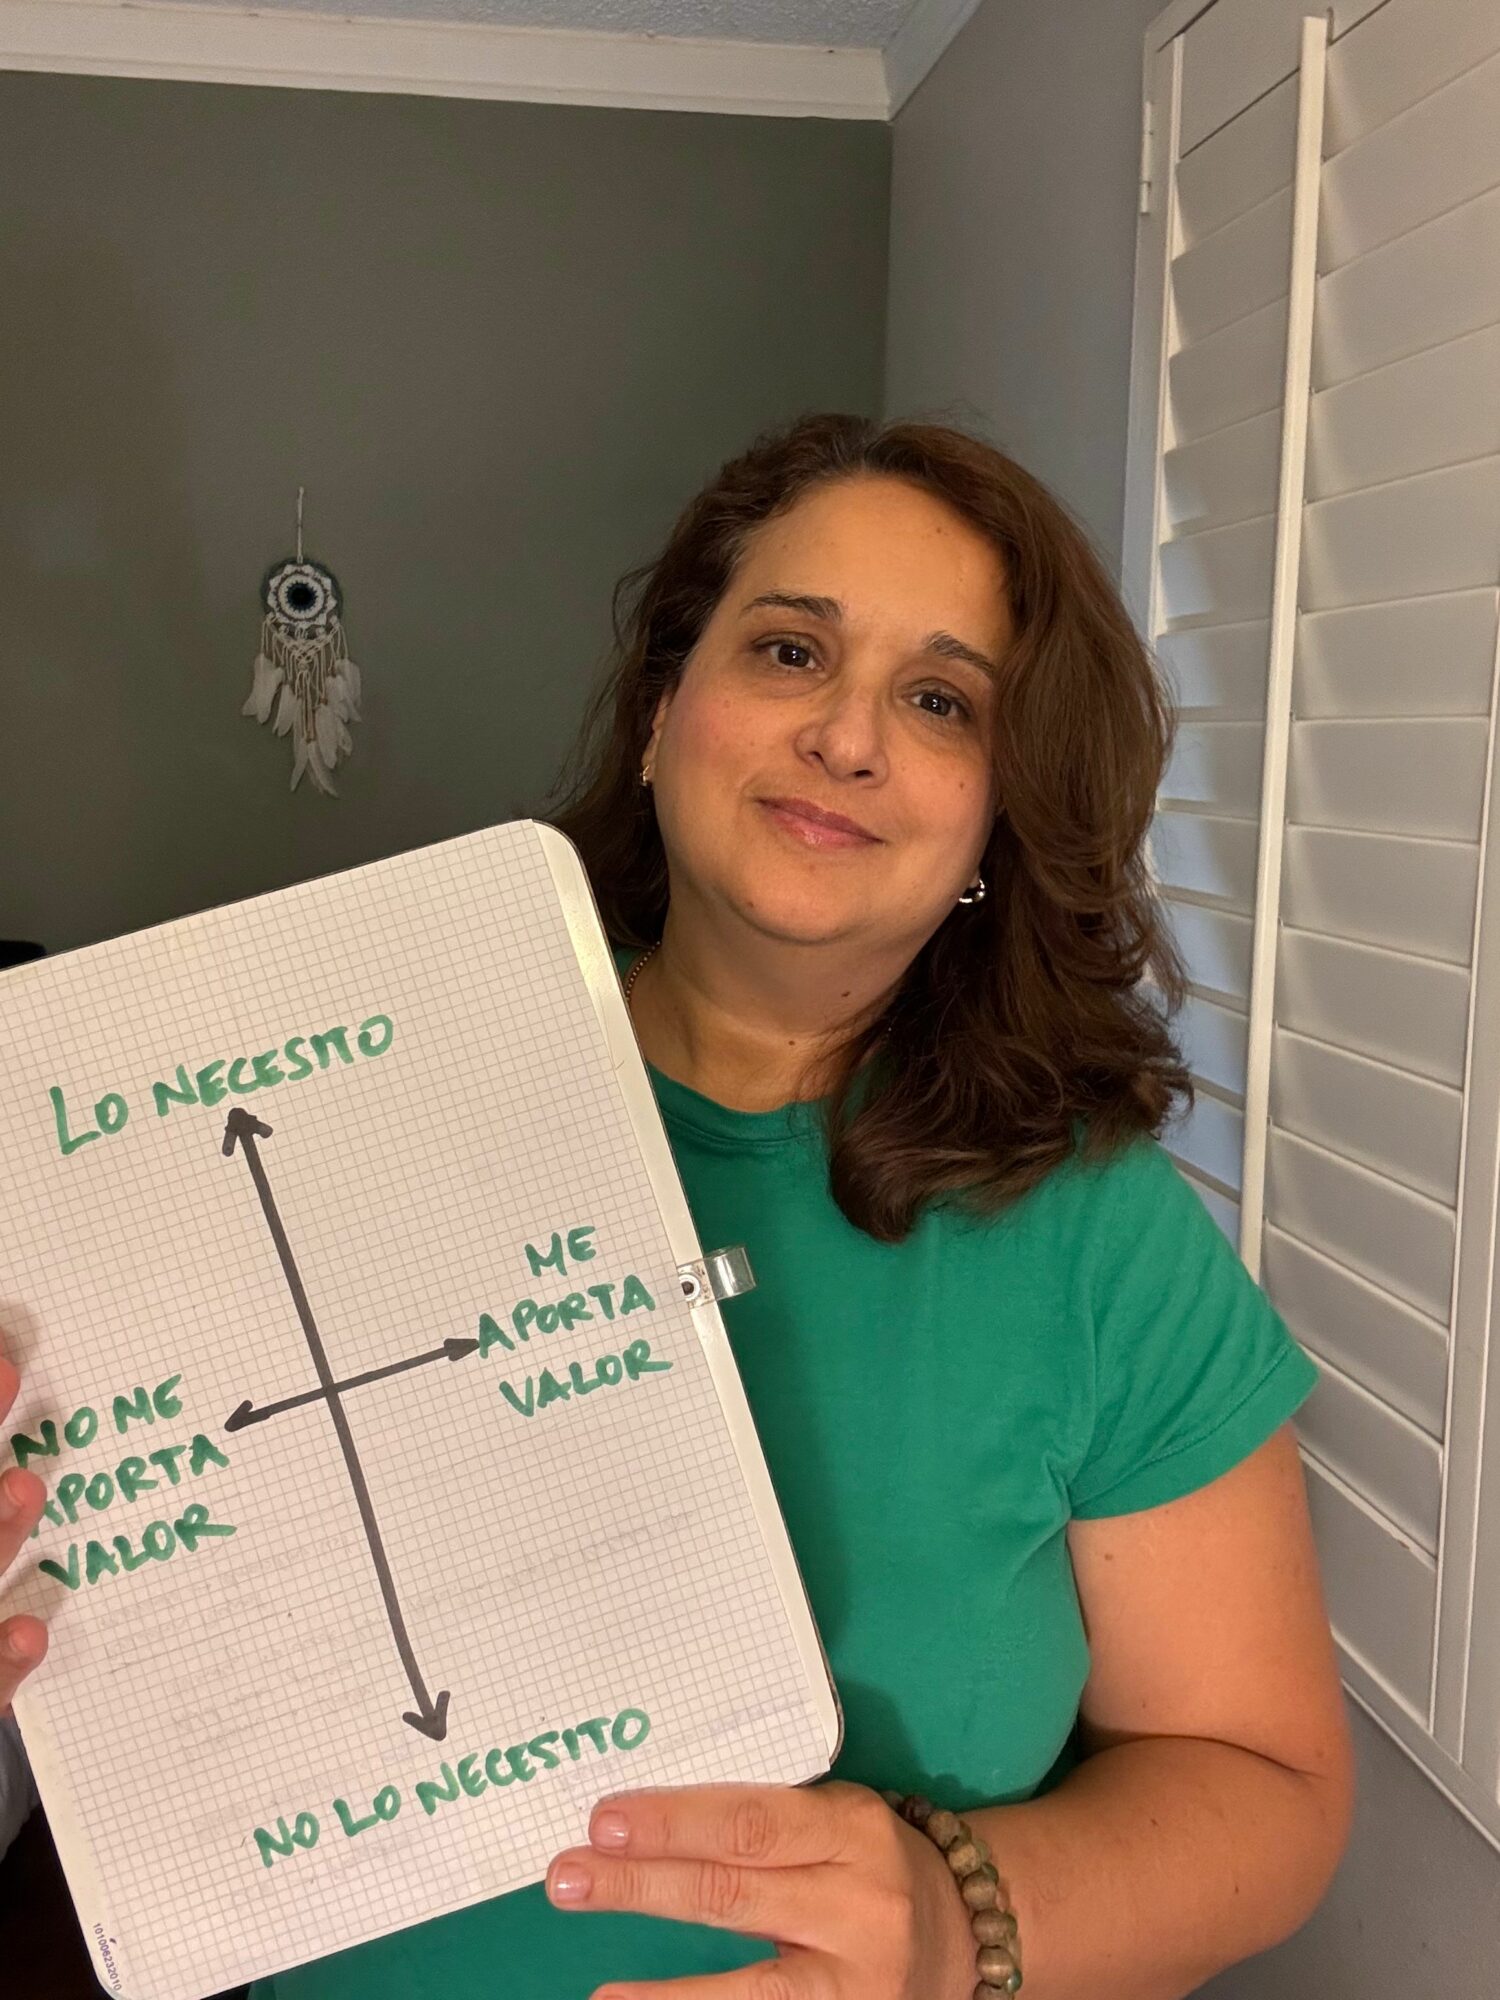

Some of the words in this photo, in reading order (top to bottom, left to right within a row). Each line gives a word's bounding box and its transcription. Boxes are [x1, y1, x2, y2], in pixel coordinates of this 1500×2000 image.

[49, 1087, 129, 1156] LO
[153, 1014, 394, 1118] NECESITO
[524, 1225, 596, 1277] ME
[479, 1274, 656, 1359] APORTA
[10, 1407, 99, 1468] NO
[112, 1373, 183, 1434] ME
[499, 1338, 673, 1417] VALOR
[38, 1503, 238, 1590] VALOR
[253, 1812, 319, 1867] NO
[332, 1785, 401, 1837] LO
[416, 1708, 650, 1816] NECESITO
[93, 1922, 122, 1991] 101006232010
